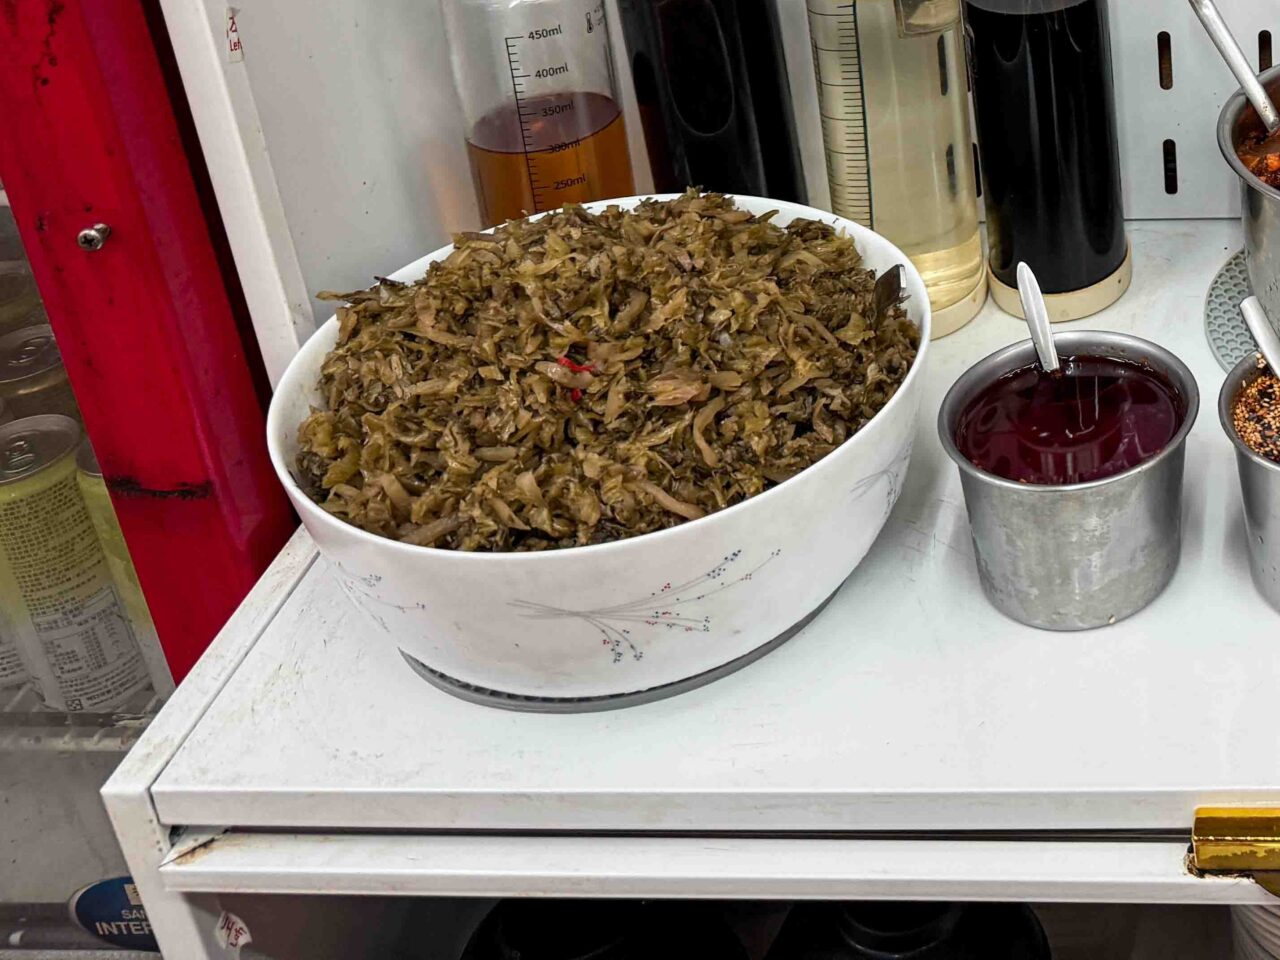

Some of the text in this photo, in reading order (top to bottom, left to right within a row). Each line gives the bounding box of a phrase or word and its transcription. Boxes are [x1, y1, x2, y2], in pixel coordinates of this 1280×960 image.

[527, 24, 562, 41] 450ml
[534, 62, 569, 79] 400ml
[541, 100, 575, 117] 350ml
[553, 173, 586, 190] 250ml
